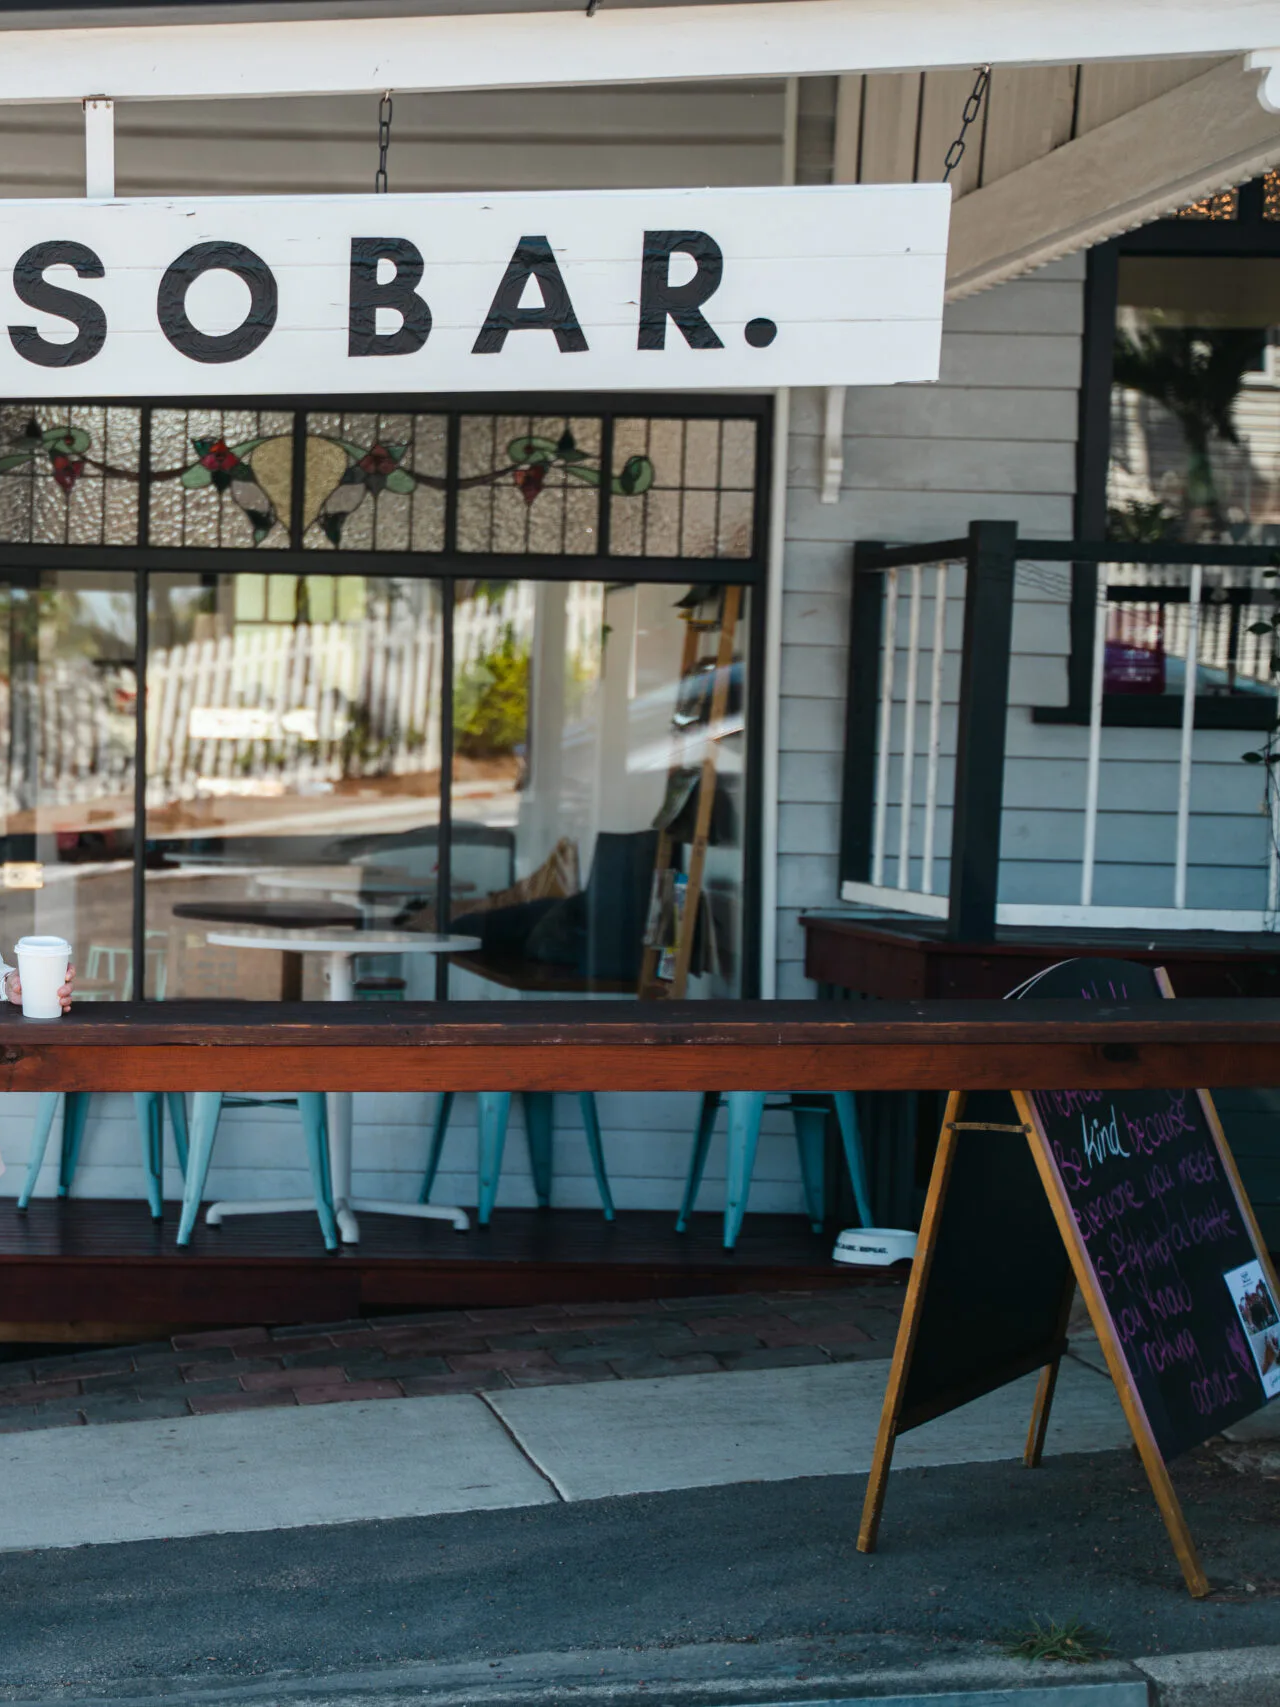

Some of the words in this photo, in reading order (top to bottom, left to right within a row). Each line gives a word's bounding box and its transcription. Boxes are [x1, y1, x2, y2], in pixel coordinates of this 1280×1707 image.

[346, 230, 778, 358] BAR.
[1121, 1106, 1197, 1155] because
[1073, 1180, 1144, 1241] everyone
[1144, 1163, 1175, 1222] you
[1178, 1143, 1219, 1184] meet
[1171, 1222, 1190, 1251] a
[1112, 1305, 1151, 1376] you
